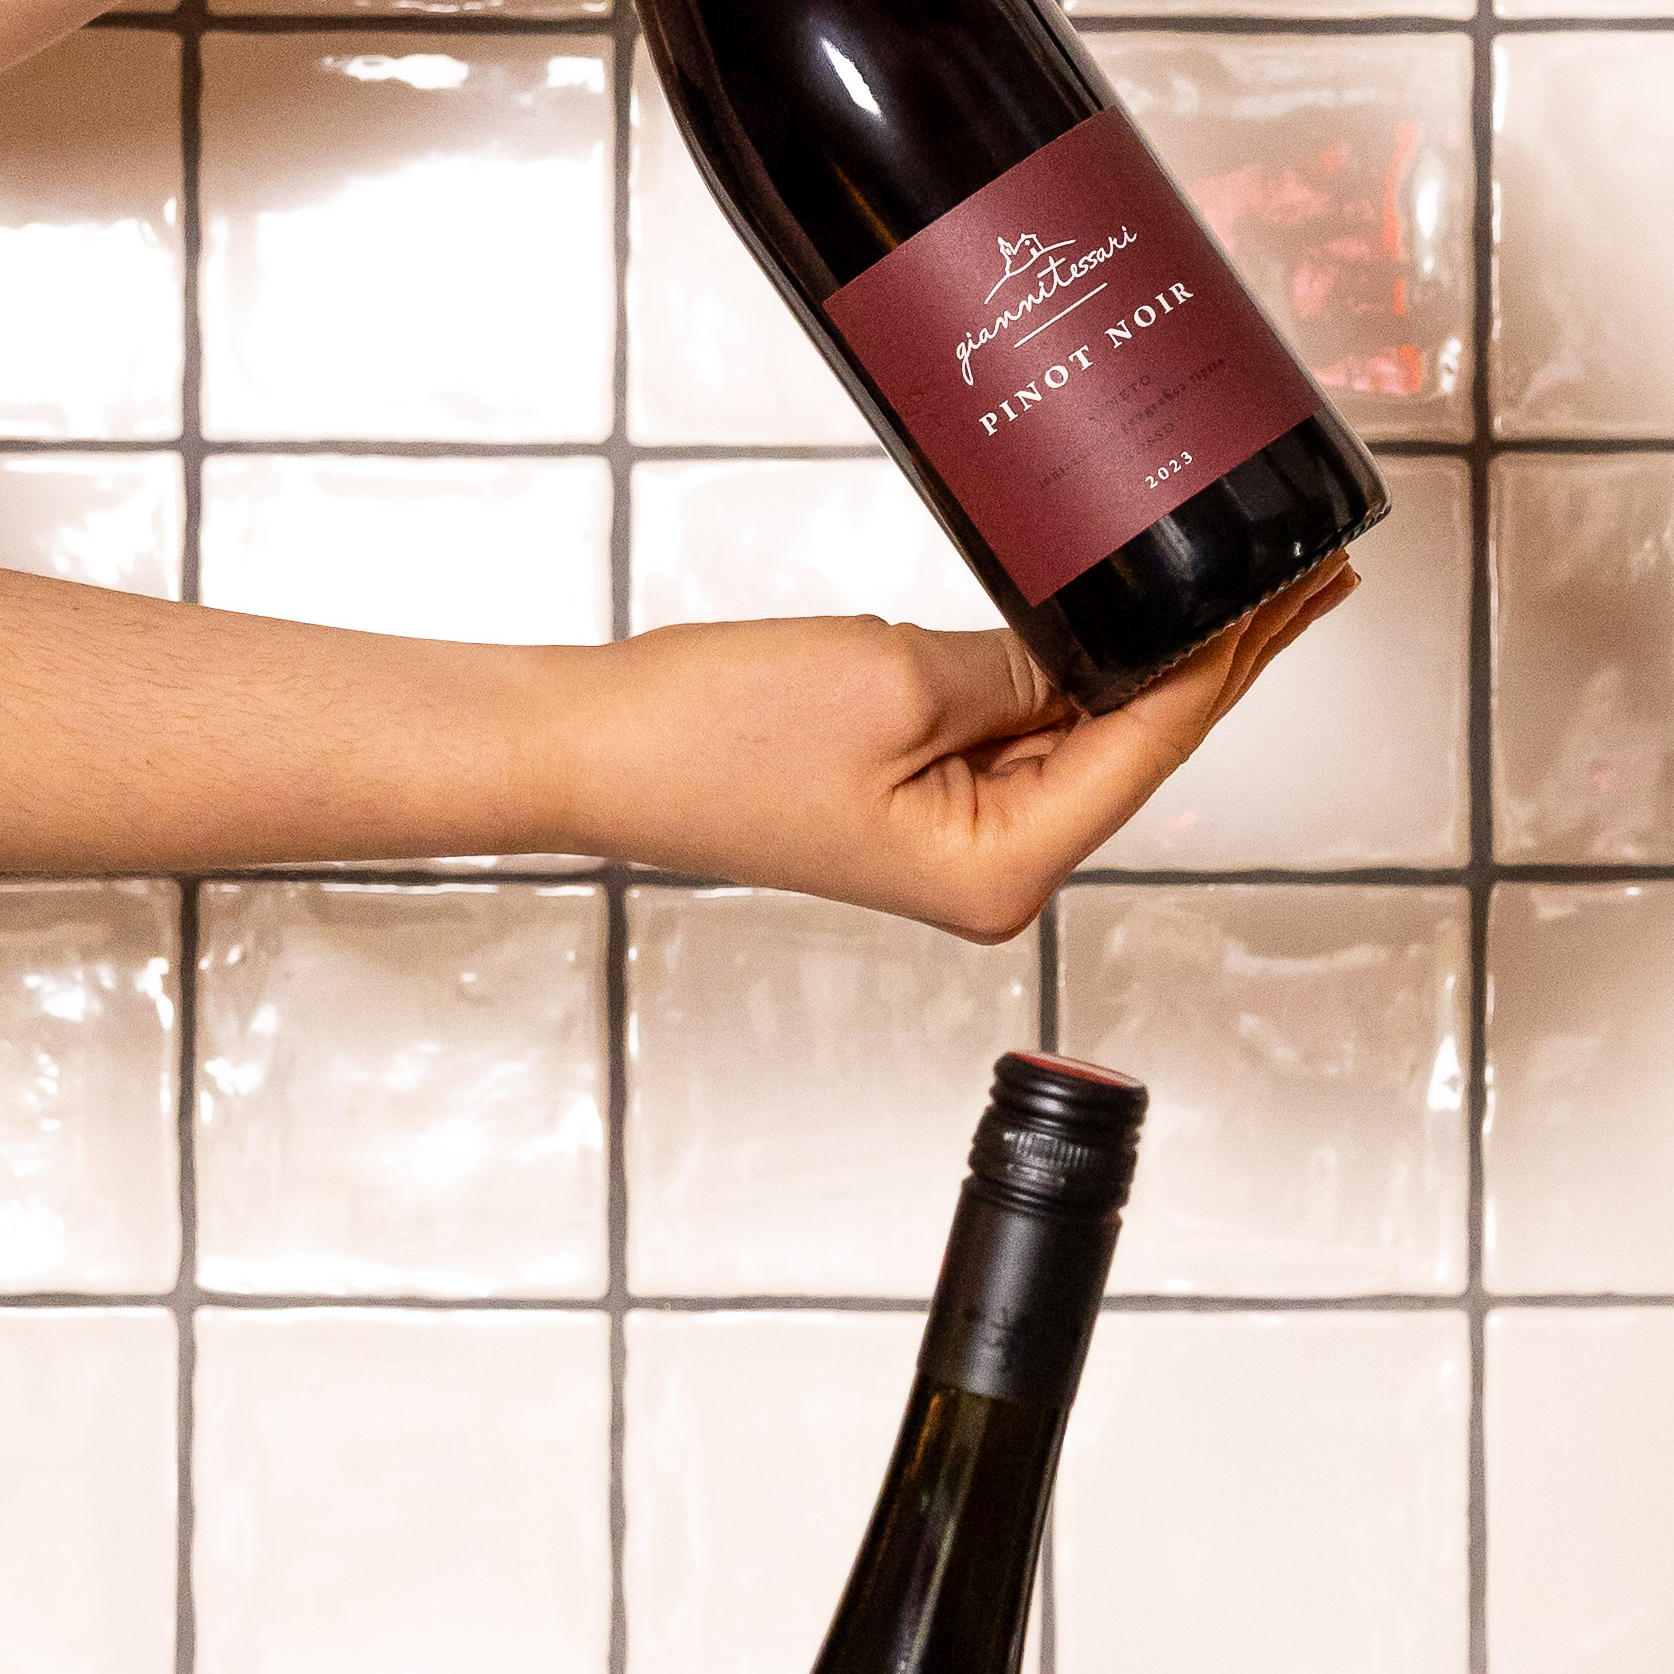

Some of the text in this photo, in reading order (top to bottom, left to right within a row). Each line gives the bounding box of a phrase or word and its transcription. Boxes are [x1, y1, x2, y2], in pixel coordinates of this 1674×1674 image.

[956, 225, 1137, 385] giannitessari
[978, 281, 1194, 436] PINOT NOIR
[1144, 450, 1193, 489] 2023
